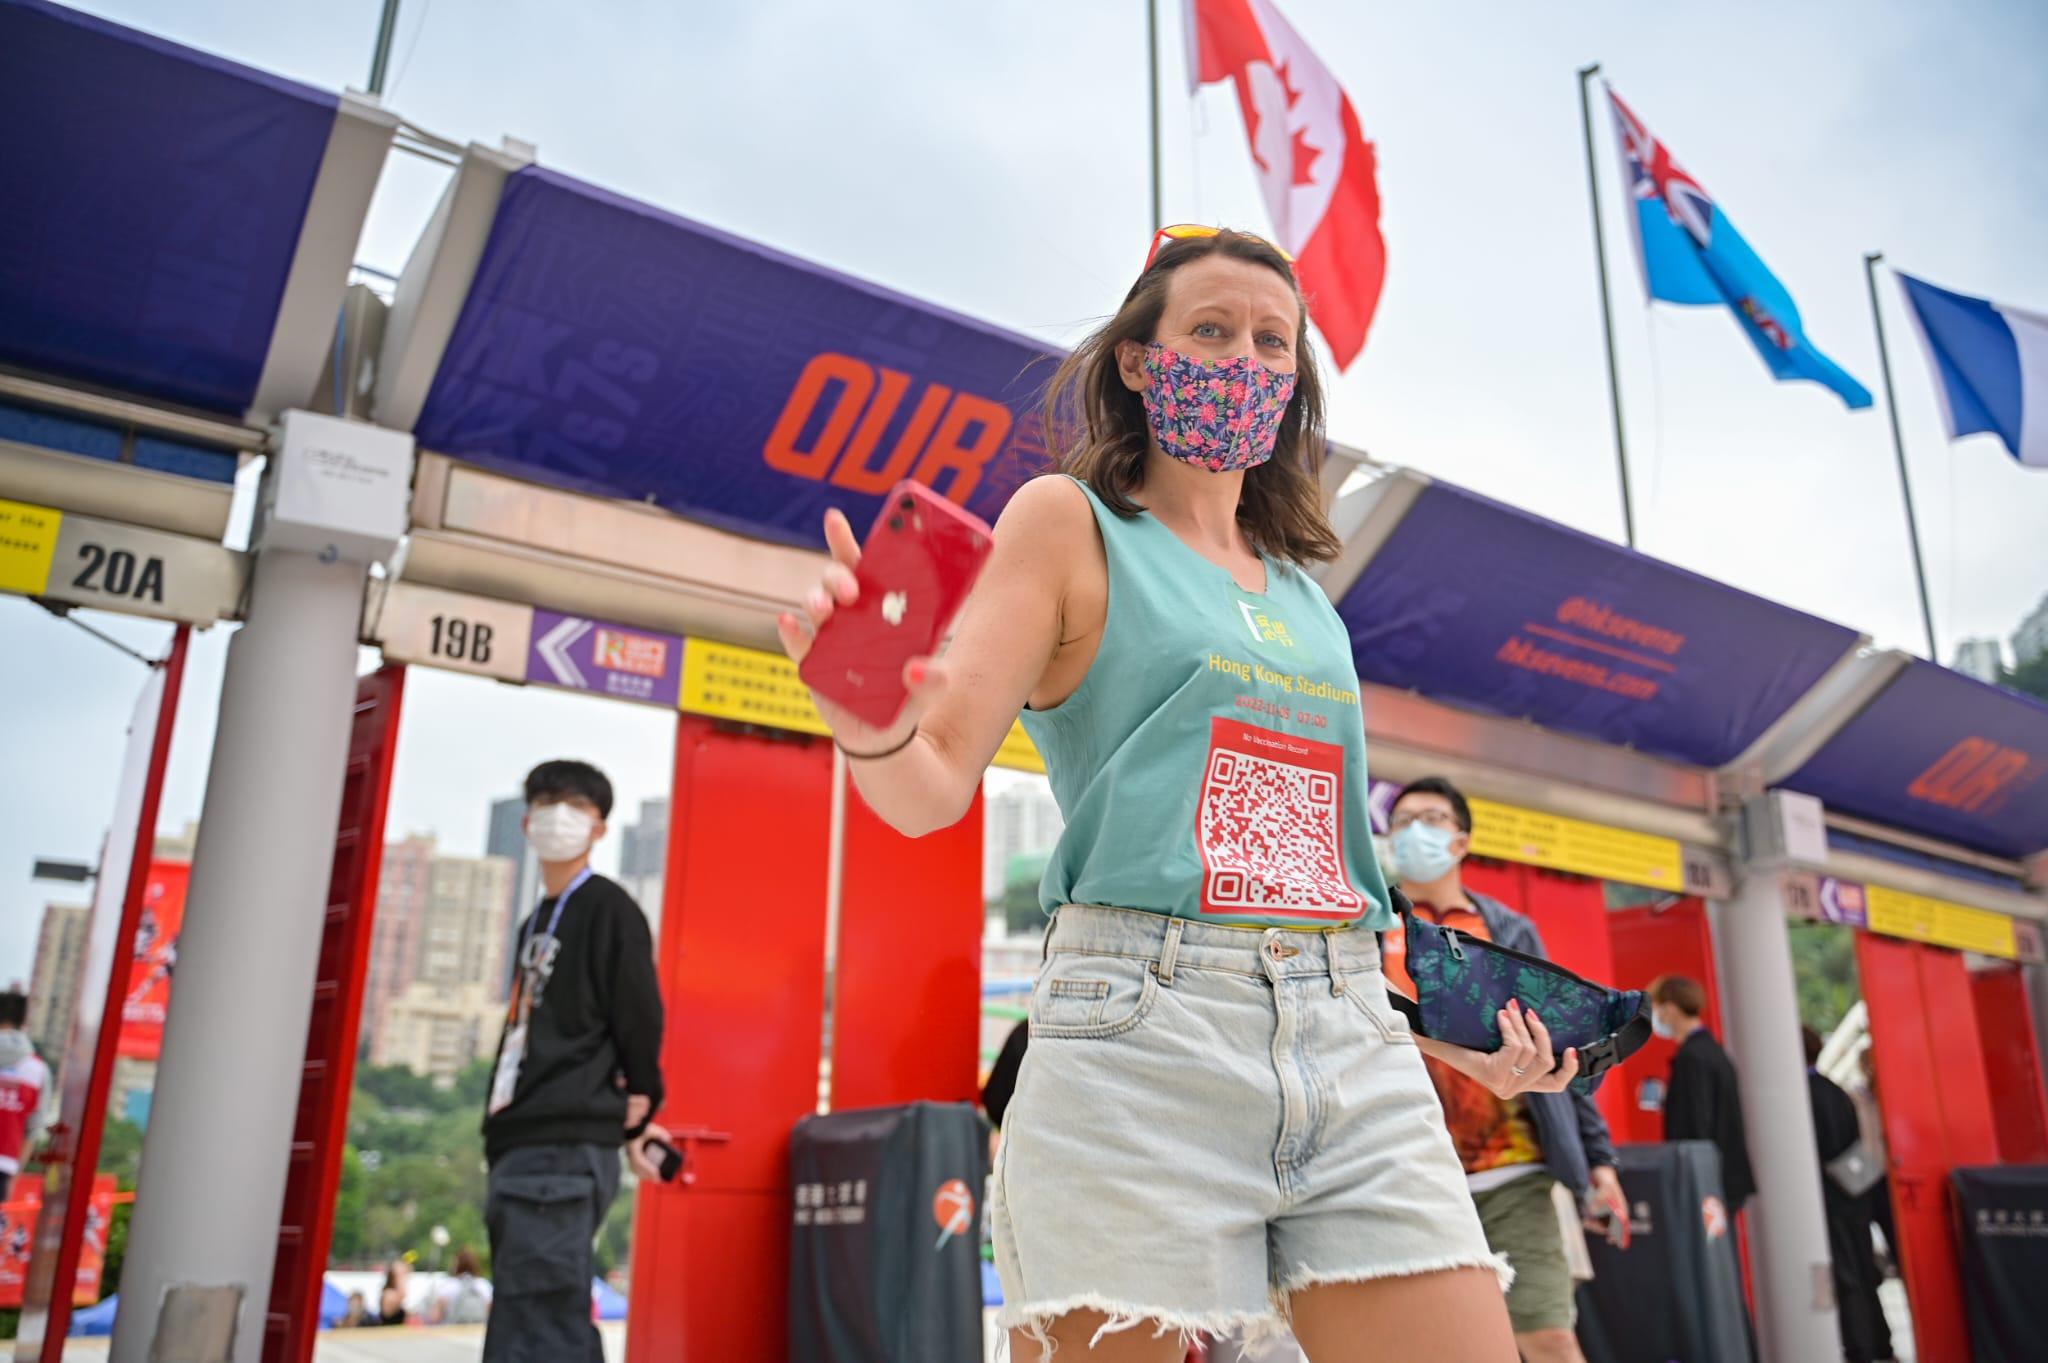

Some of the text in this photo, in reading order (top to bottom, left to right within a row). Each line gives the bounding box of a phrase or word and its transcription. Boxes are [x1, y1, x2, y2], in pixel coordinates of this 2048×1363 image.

[763, 353, 1013, 508] OUR
[72, 542, 164, 604] 20A
[430, 614, 494, 665] 19B
[1208, 653, 1357, 705] Hong Kong Stadium
[1242, 732, 1309, 755] No Vaccination Record
